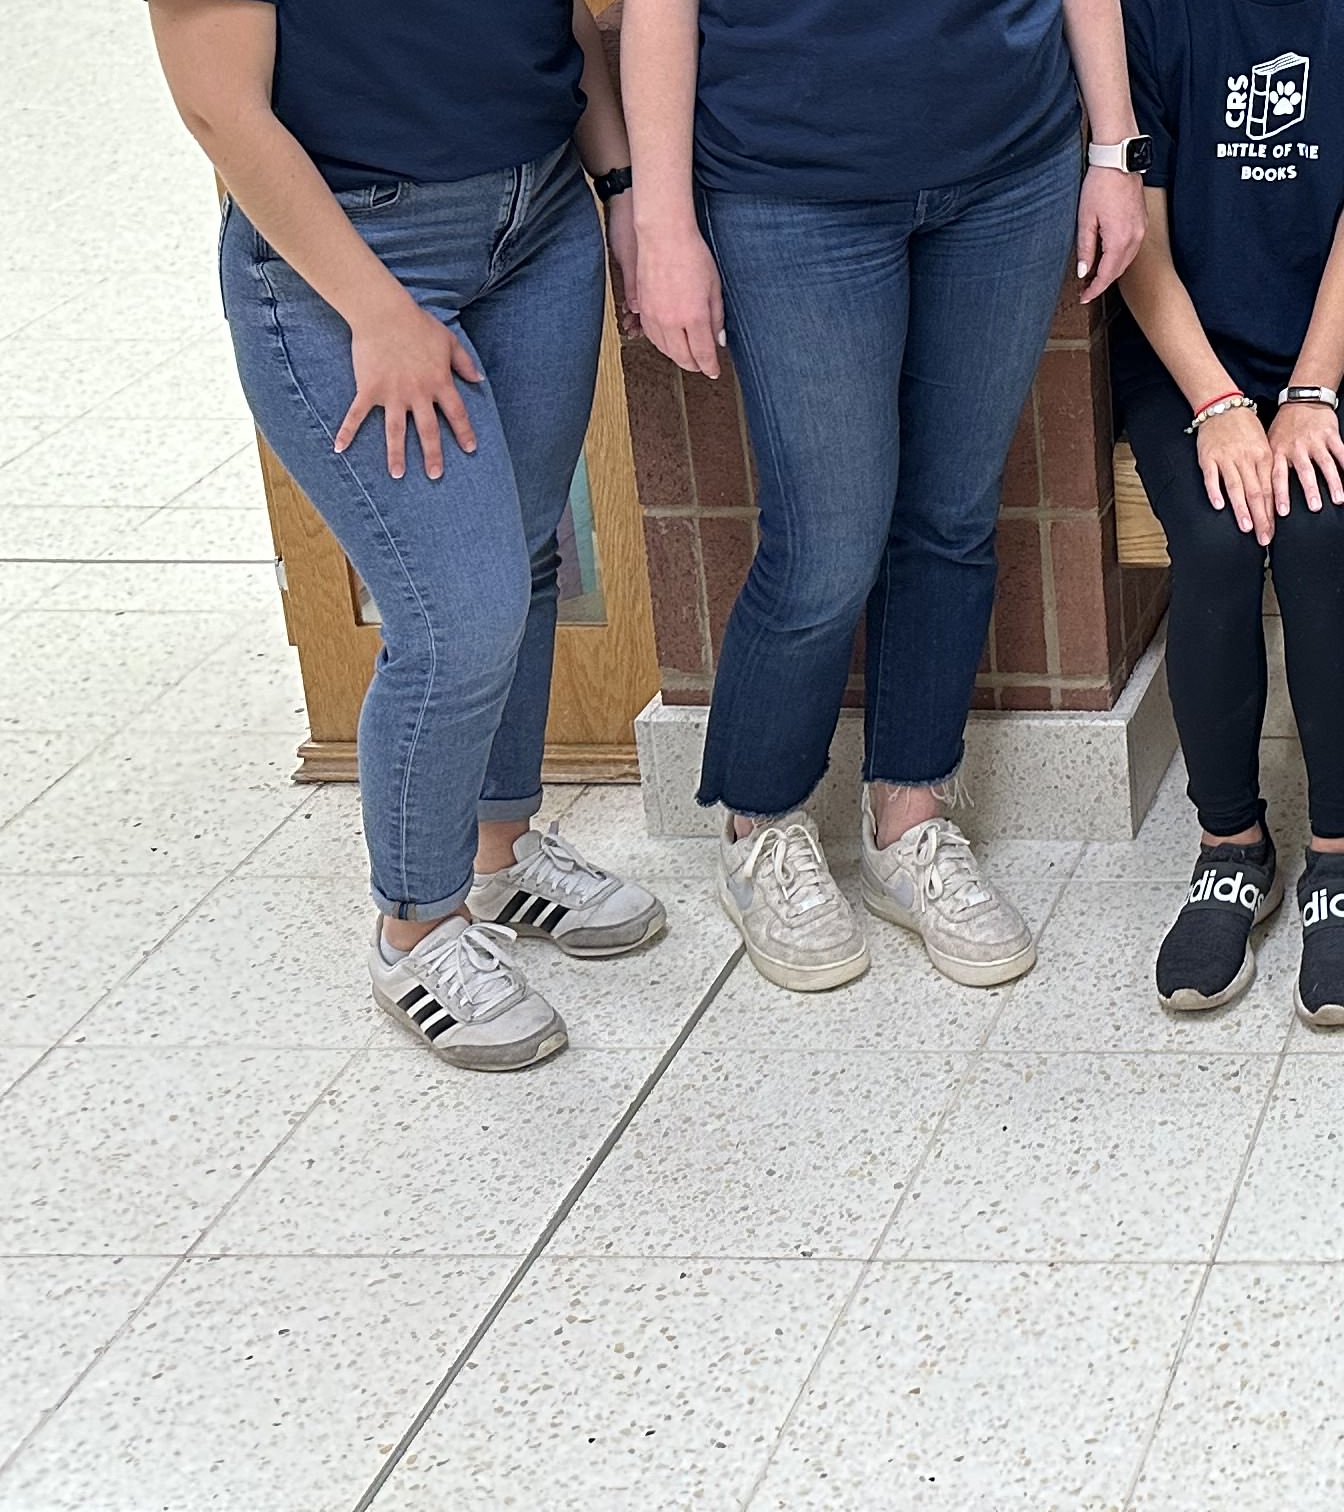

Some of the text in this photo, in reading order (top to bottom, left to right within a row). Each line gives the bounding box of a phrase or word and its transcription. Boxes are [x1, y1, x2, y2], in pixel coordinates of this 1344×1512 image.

[1225, 74, 1248, 128] CRS
[1216, 143, 1267, 158] BATTLE
[1272, 143, 1292, 158] OF
[1241, 165, 1297, 182] BOOKS
